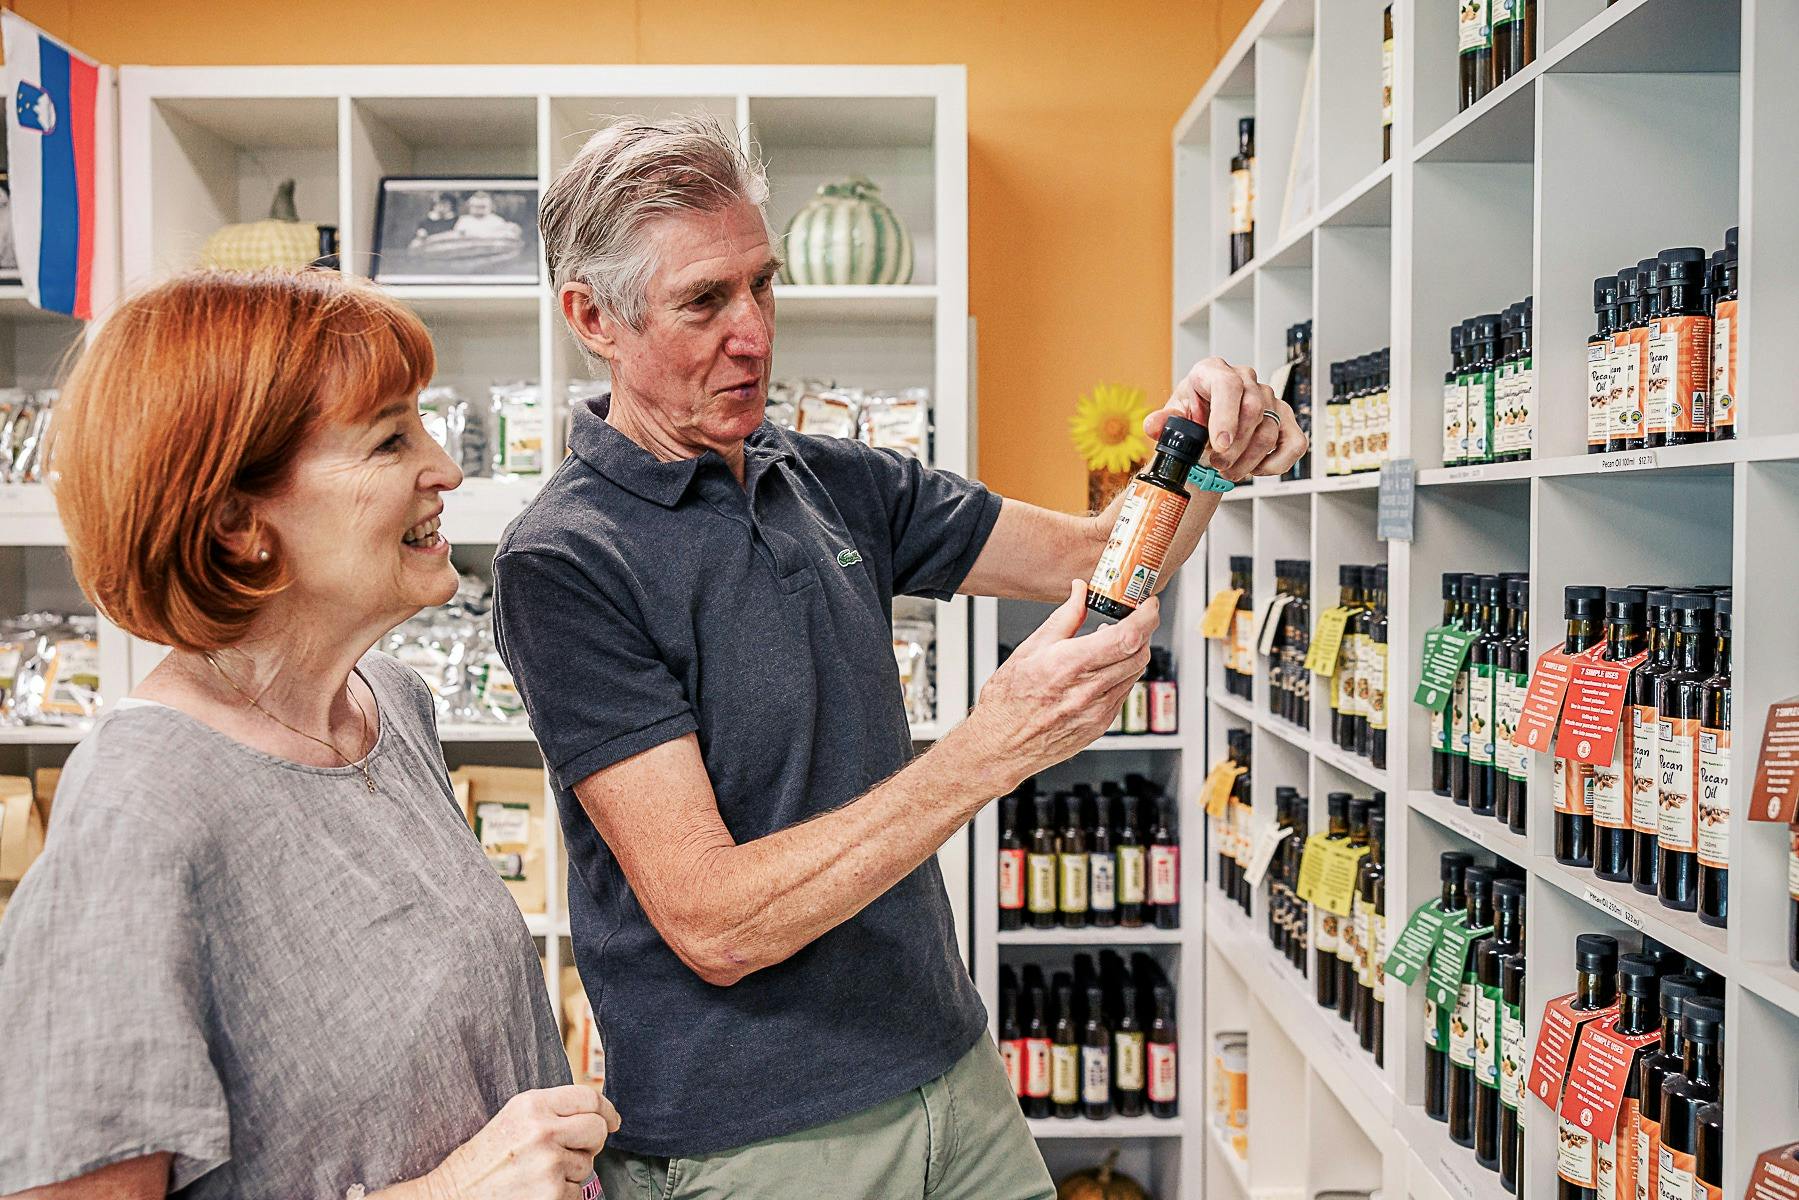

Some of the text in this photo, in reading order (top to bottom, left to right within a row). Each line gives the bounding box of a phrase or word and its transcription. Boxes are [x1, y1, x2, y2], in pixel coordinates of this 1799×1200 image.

[1585, 668, 1605, 678] SIMPLE
[1605, 670, 1619, 680] USES
[1660, 754, 1682, 771] Pecan
[1662, 772, 1674, 784] Oil
[1701, 767, 1728, 785] Pecan
[1705, 786, 1717, 799] Oil
[1593, 1033, 1611, 1048] SIMPLE
[1611, 1042, 1624, 1054] USES
